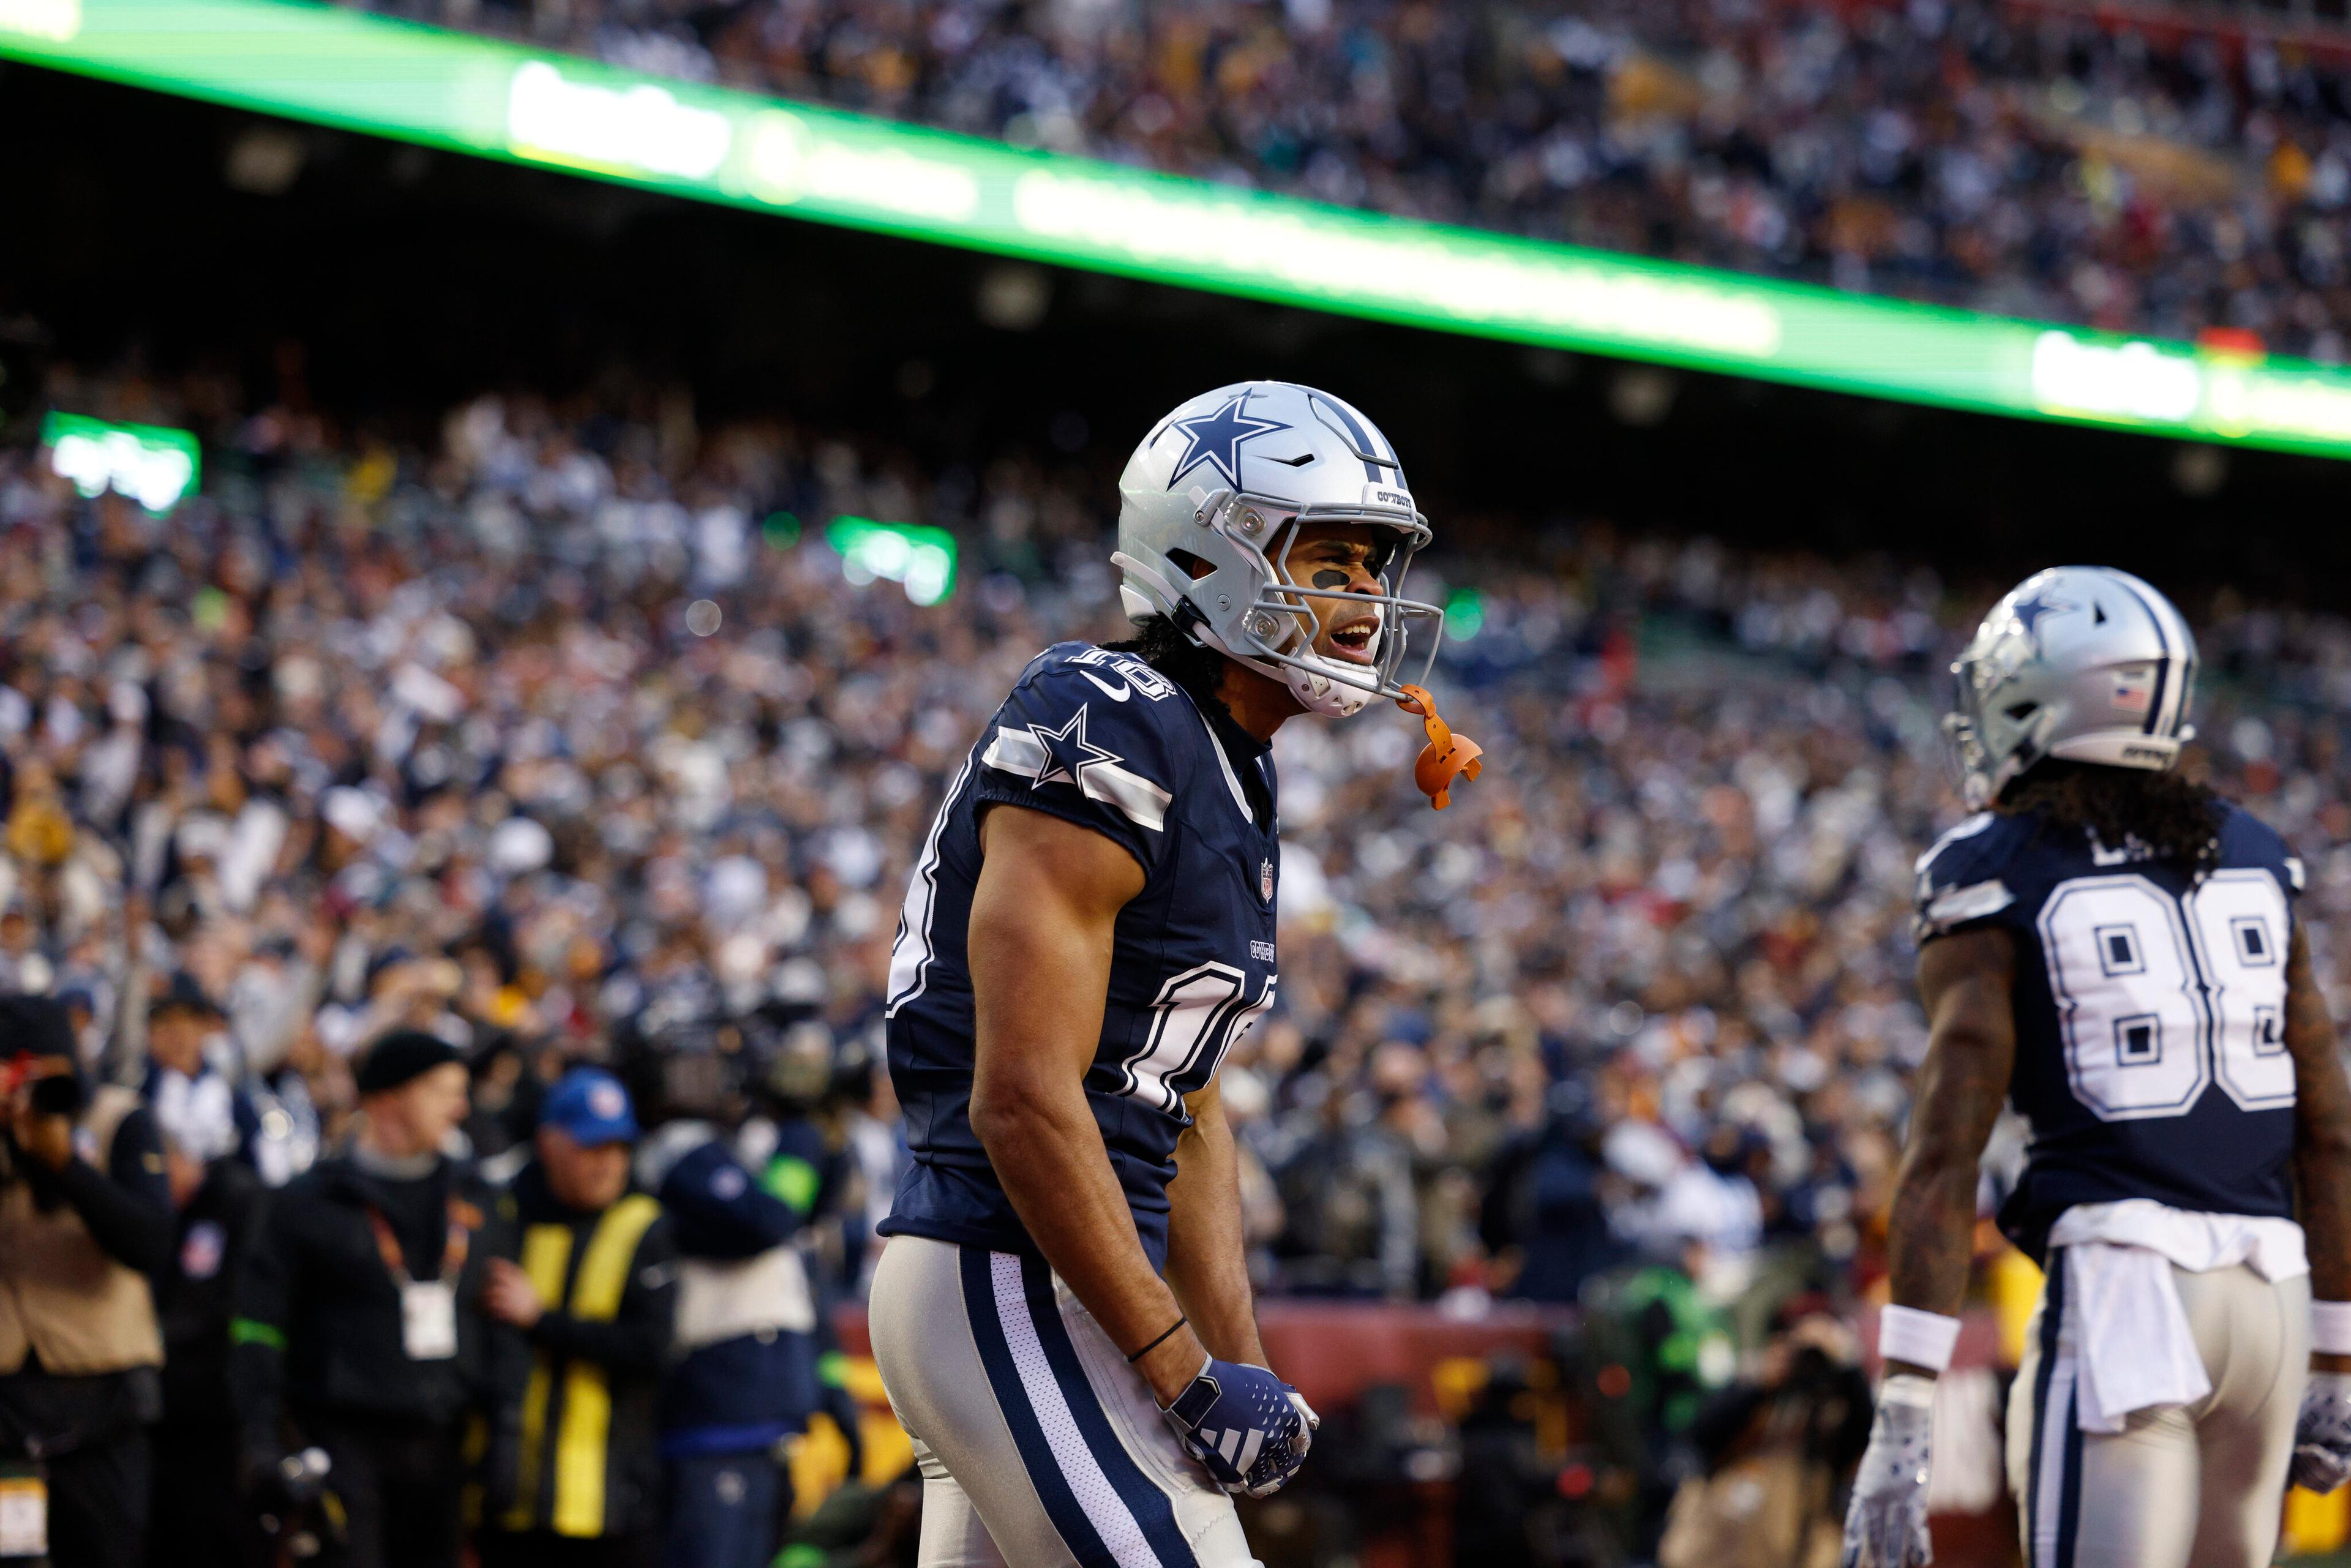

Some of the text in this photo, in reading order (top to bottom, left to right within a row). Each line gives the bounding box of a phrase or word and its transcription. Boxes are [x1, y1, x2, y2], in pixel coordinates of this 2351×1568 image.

[1377, 491, 1412, 509] COWBOYS
[1250, 940, 1275, 963] COWB
[2036, 868, 2297, 1122] 88
